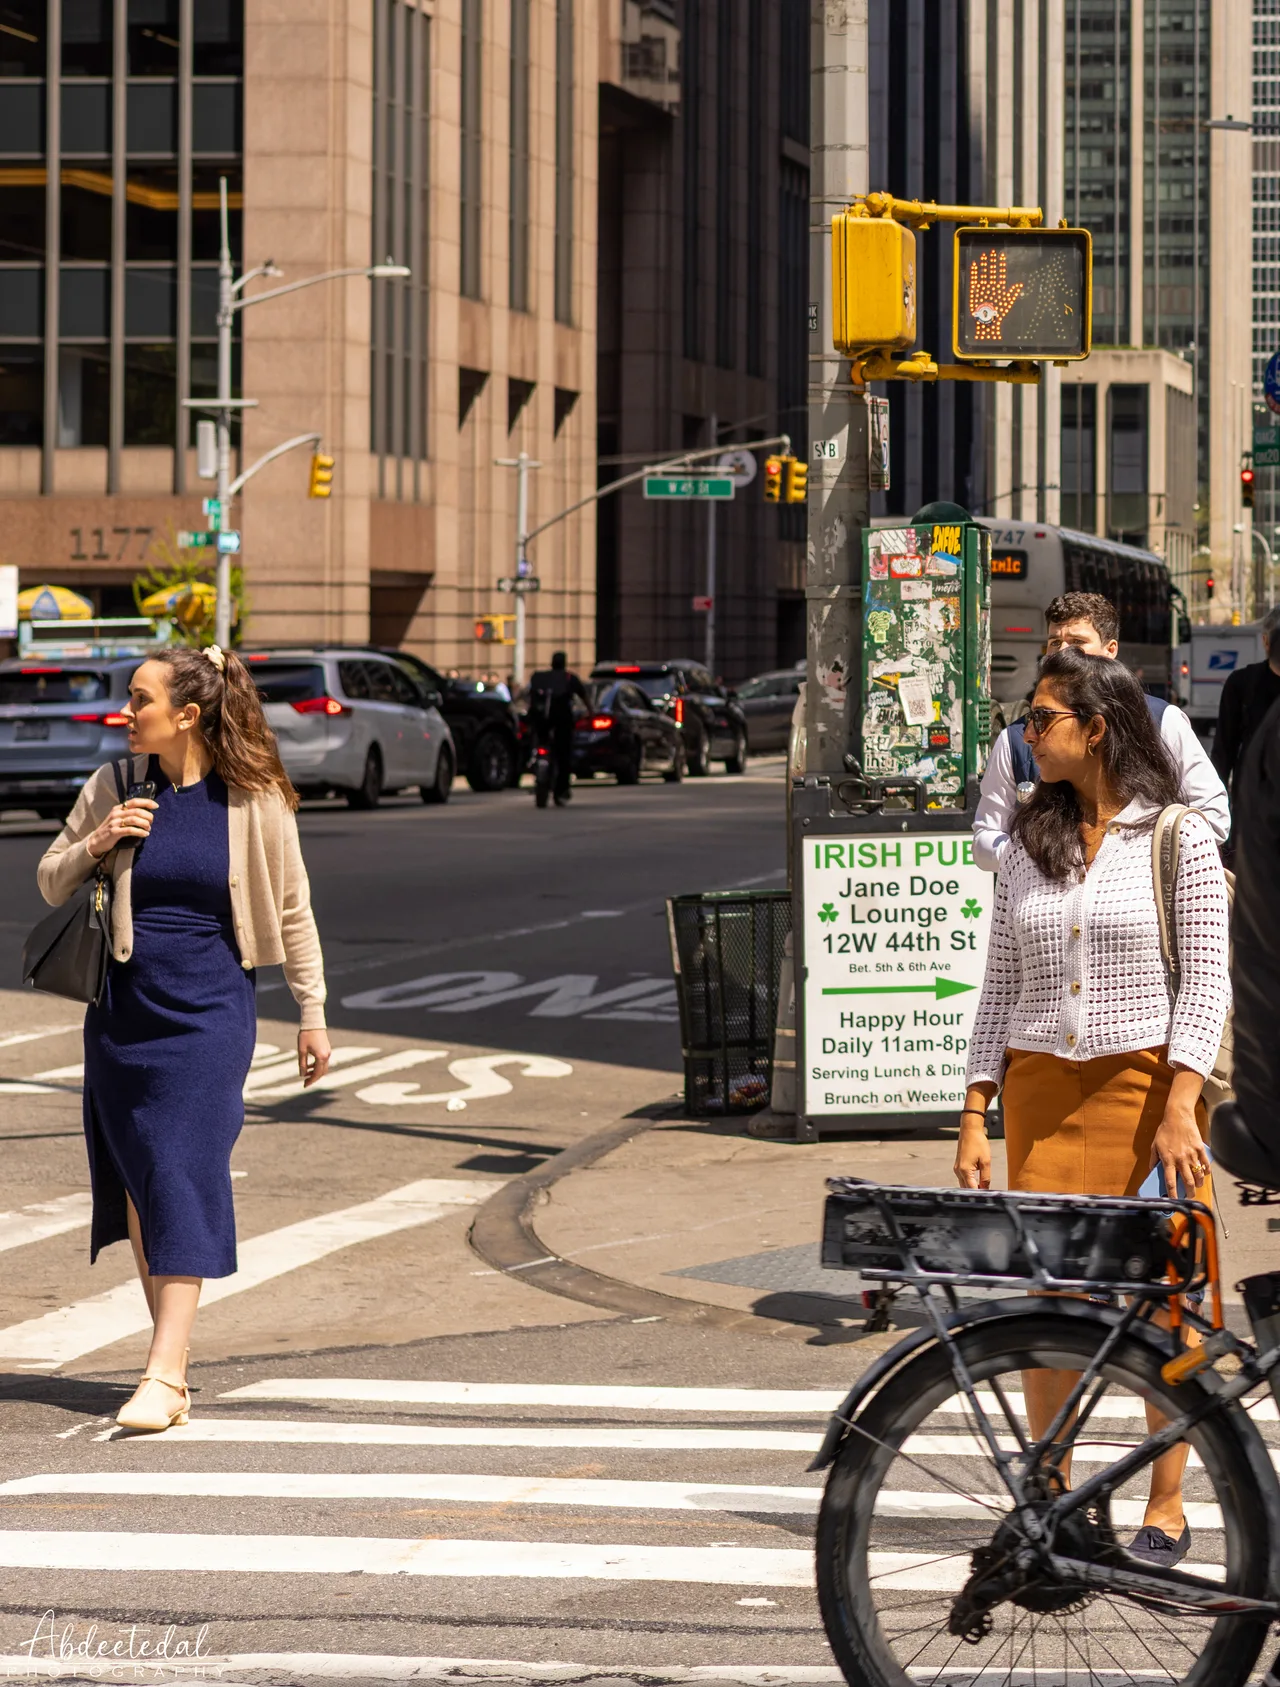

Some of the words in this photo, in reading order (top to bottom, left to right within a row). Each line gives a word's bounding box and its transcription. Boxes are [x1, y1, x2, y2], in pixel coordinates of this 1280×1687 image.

[70, 527, 155, 561] 1177
[814, 843, 902, 869] IRISH
[838, 878, 900, 899] Jane
[910, 876, 960, 896] Doe
[851, 904, 948, 928] Lounge
[823, 933, 878, 954] 12W
[885, 932, 940, 953] 44th
[950, 930, 977, 951] St
[850, 964, 872, 973] Bet.
[875, 964, 893, 973] 5th
[896, 963, 905, 972] &
[908, 963, 927, 972] 6th
[929, 962, 951, 971] Ave
[840, 1012, 906, 1032] Happy
[913, 1010, 964, 1027] Hour
[822, 1037, 873, 1058] Daily
[881, 1035, 970, 1055] 11am-8p
[812, 1068, 869, 1082] Serving
[874, 1066, 921, 1078] Lunch
[925, 1065, 936, 1077] &
[941, 1064, 965, 1076] Din
[824, 1092, 879, 1105] Brunch
[883, 1094, 903, 1103] on
[907, 1091, 965, 1103] Weeken
